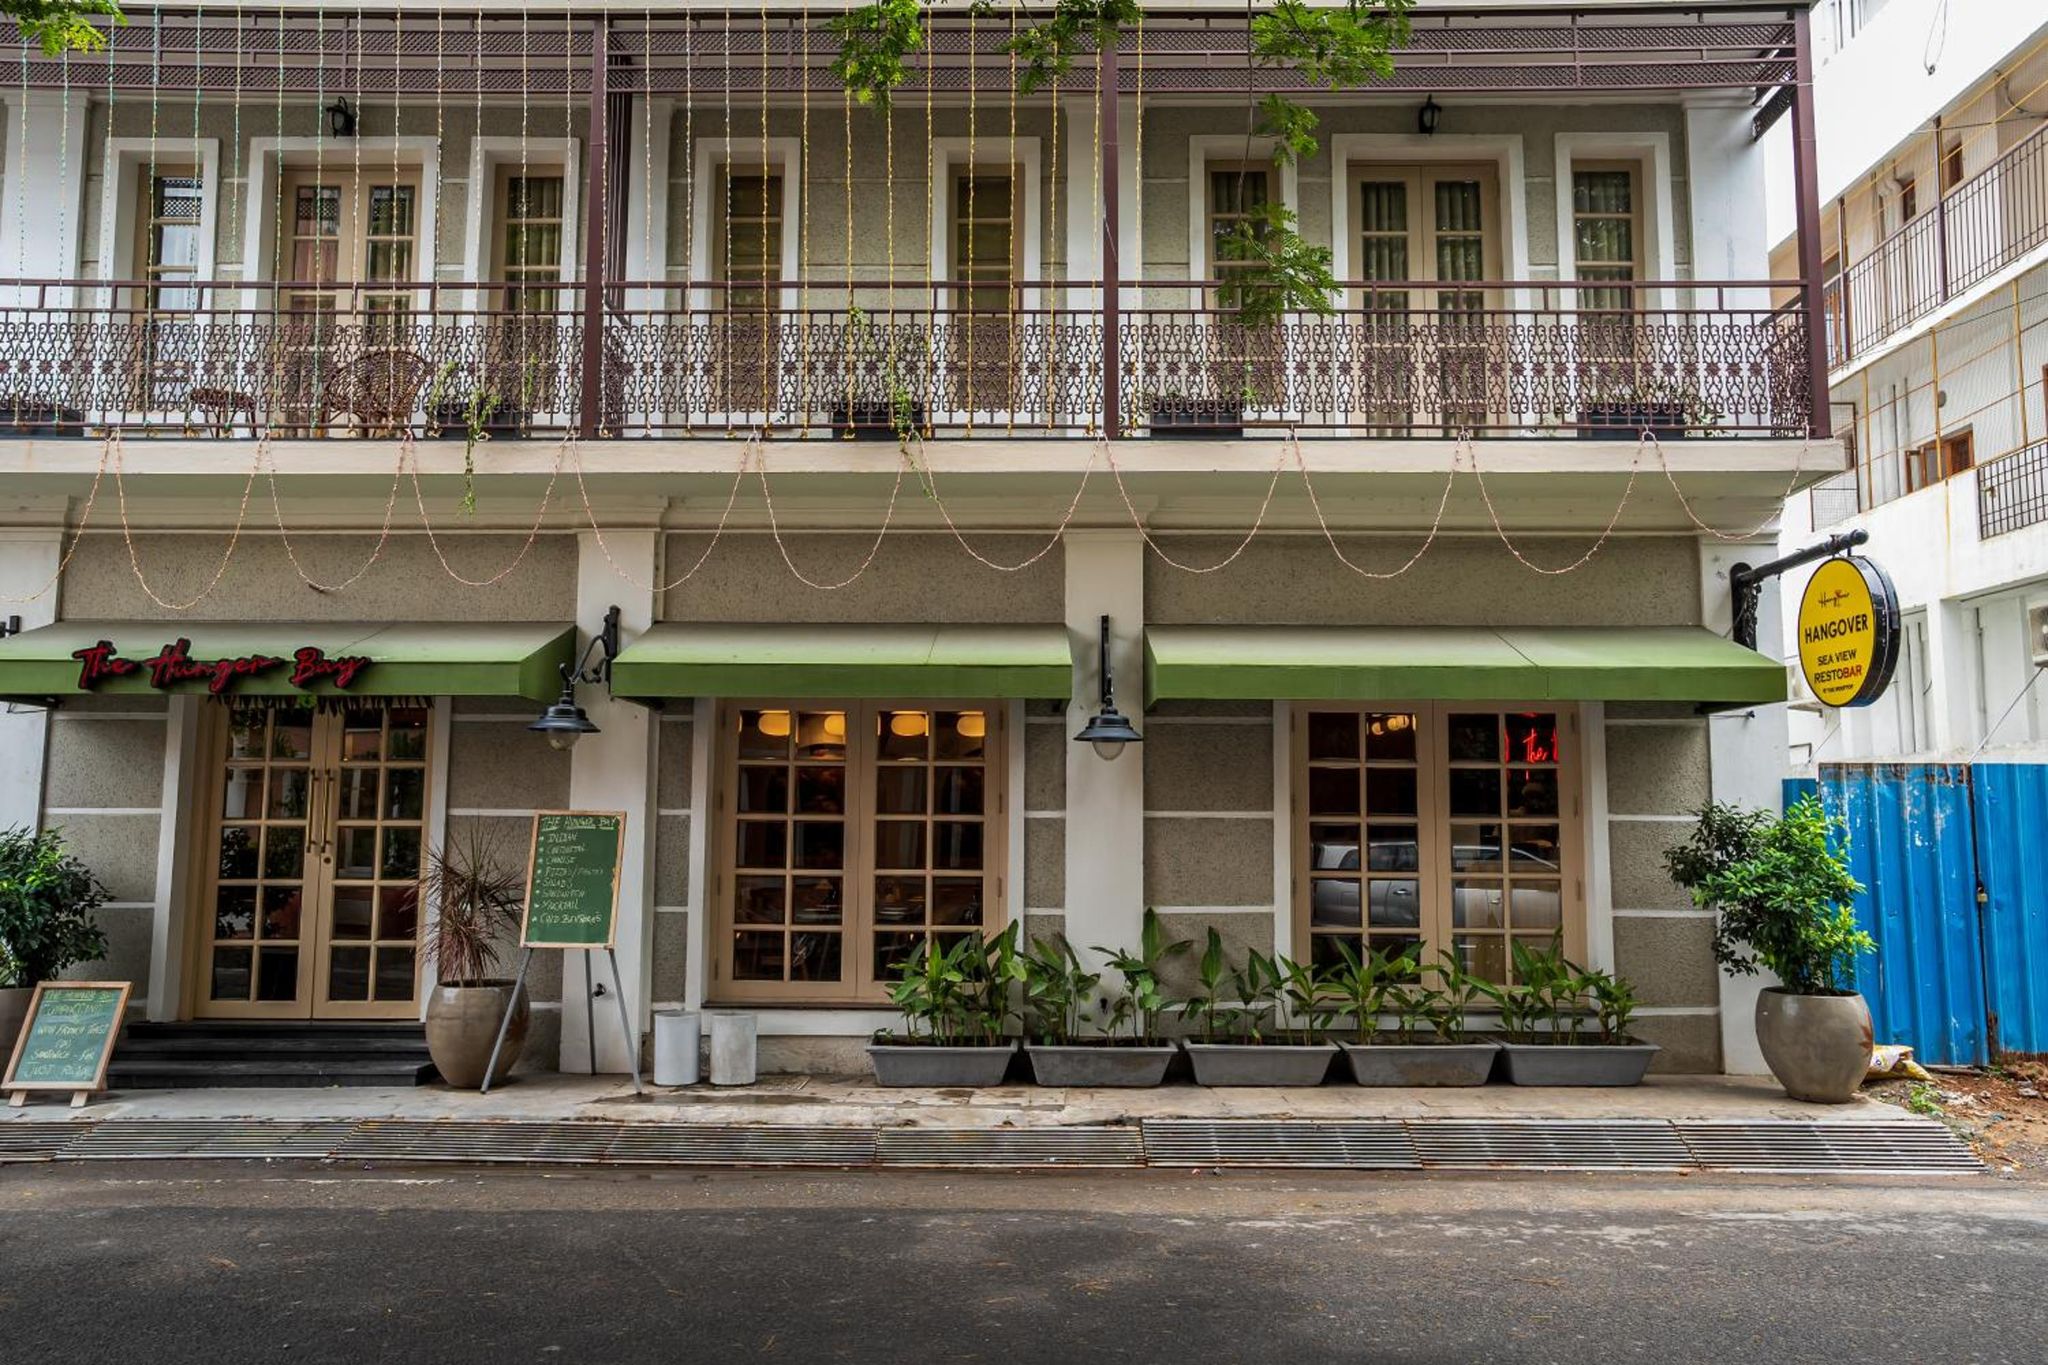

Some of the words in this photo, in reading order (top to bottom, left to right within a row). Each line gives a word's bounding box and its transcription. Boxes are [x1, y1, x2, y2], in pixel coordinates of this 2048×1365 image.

[1805, 613, 1868, 644] HANGOVER
[72, 640, 143, 690] The
[288, 646, 372, 689] Bay
[1818, 654, 1835, 666] SEA
[1836, 648, 1857, 662] VIEW
[1813, 664, 1863, 684] RESTOBAR
